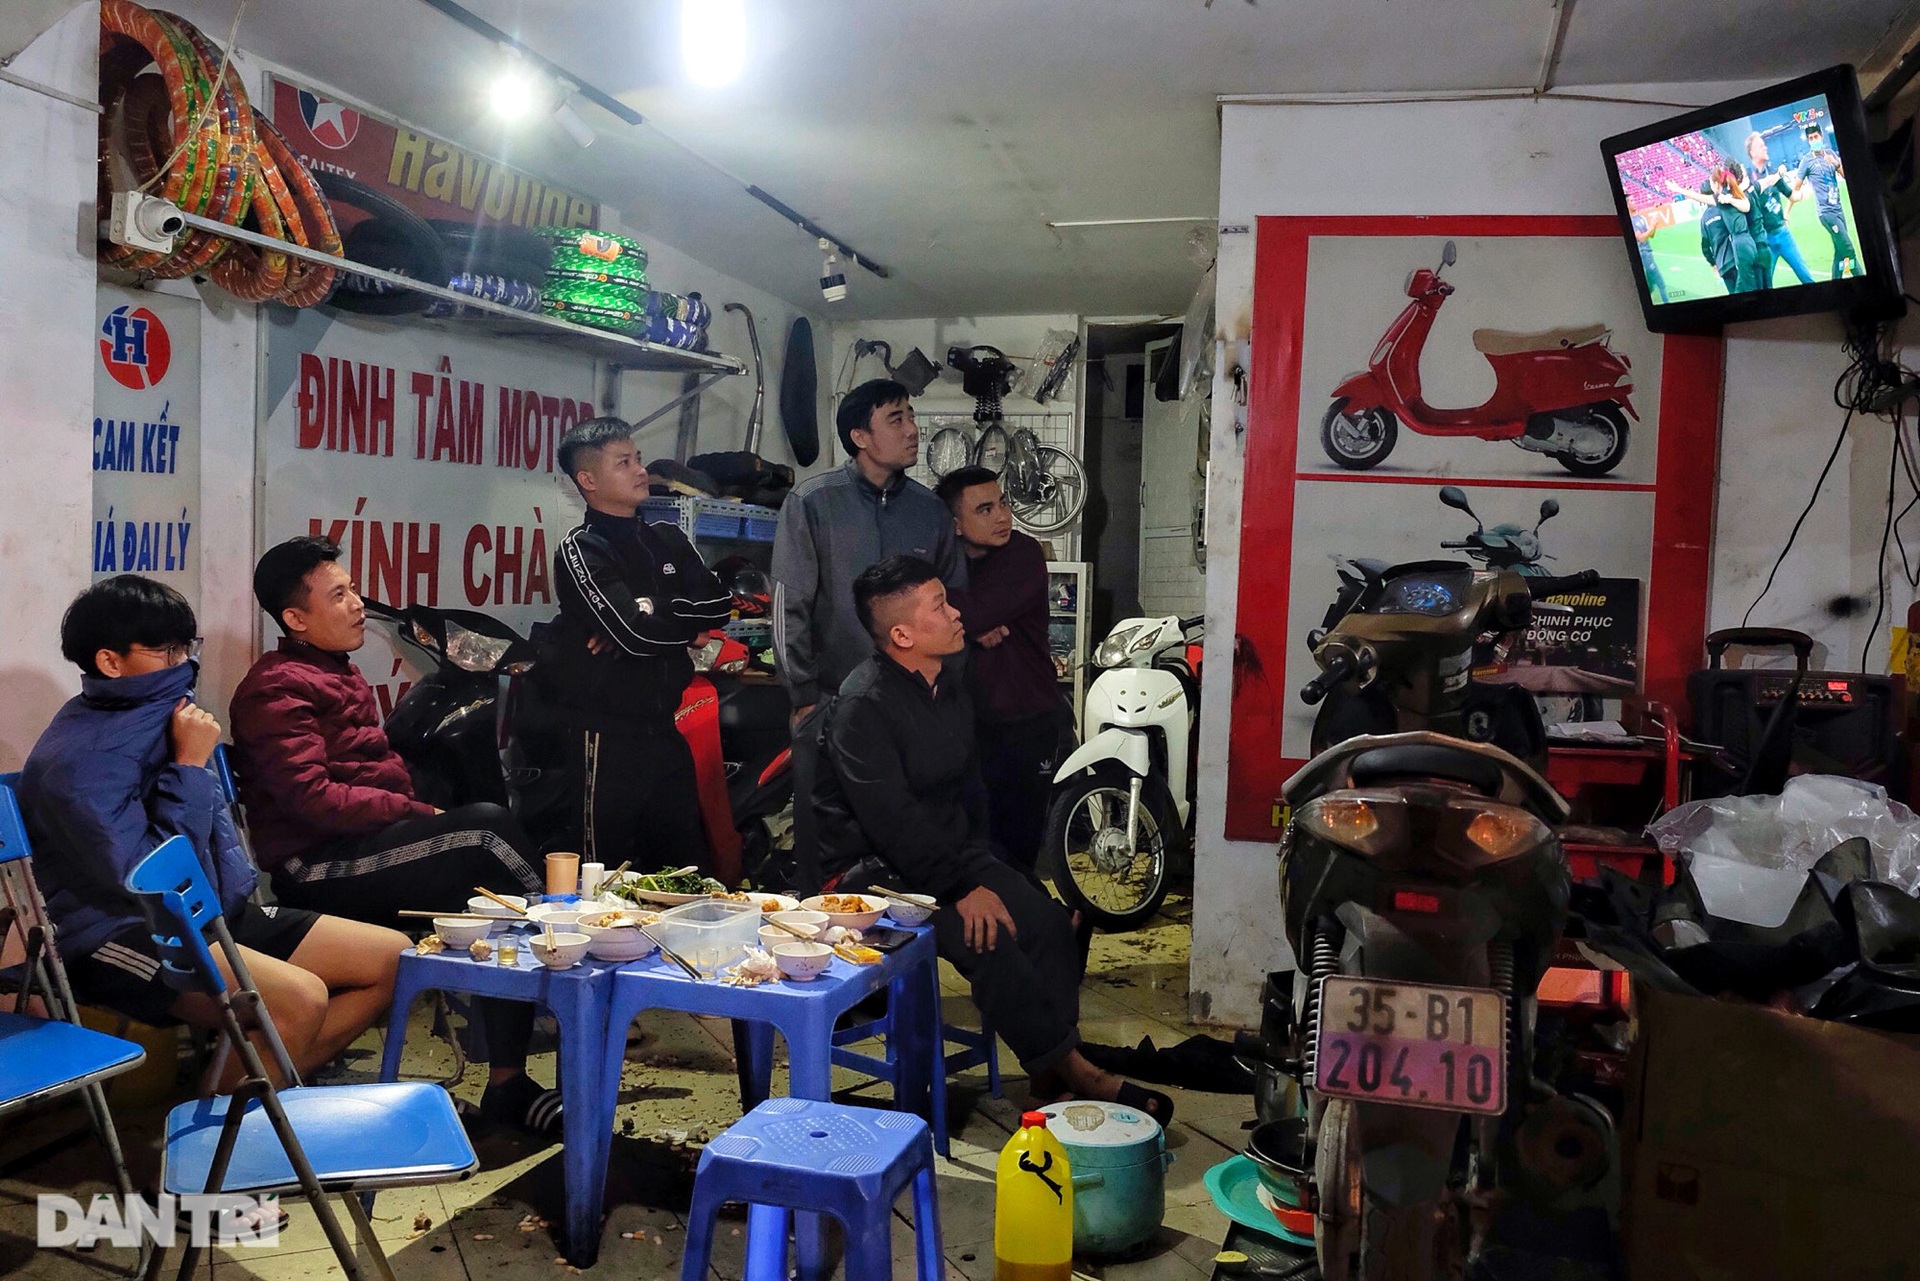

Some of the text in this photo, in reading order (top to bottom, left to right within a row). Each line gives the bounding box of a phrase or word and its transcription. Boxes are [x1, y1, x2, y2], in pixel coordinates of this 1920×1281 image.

[387, 129, 593, 228] Havoline
[93, 400, 180, 474] CAM KẾT
[296, 353, 595, 473] ĐINH TÂM MOTO
[165, 506, 191, 571] LÝ
[309, 497, 440, 609] ÍNH
[1527, 627, 1592, 642] ĐỘNG CƠ
[1574, 616, 1613, 629] PHỤC
[1346, 986, 1474, 1044] 35-B1
[1326, 1039, 1492, 1104] 204.10
